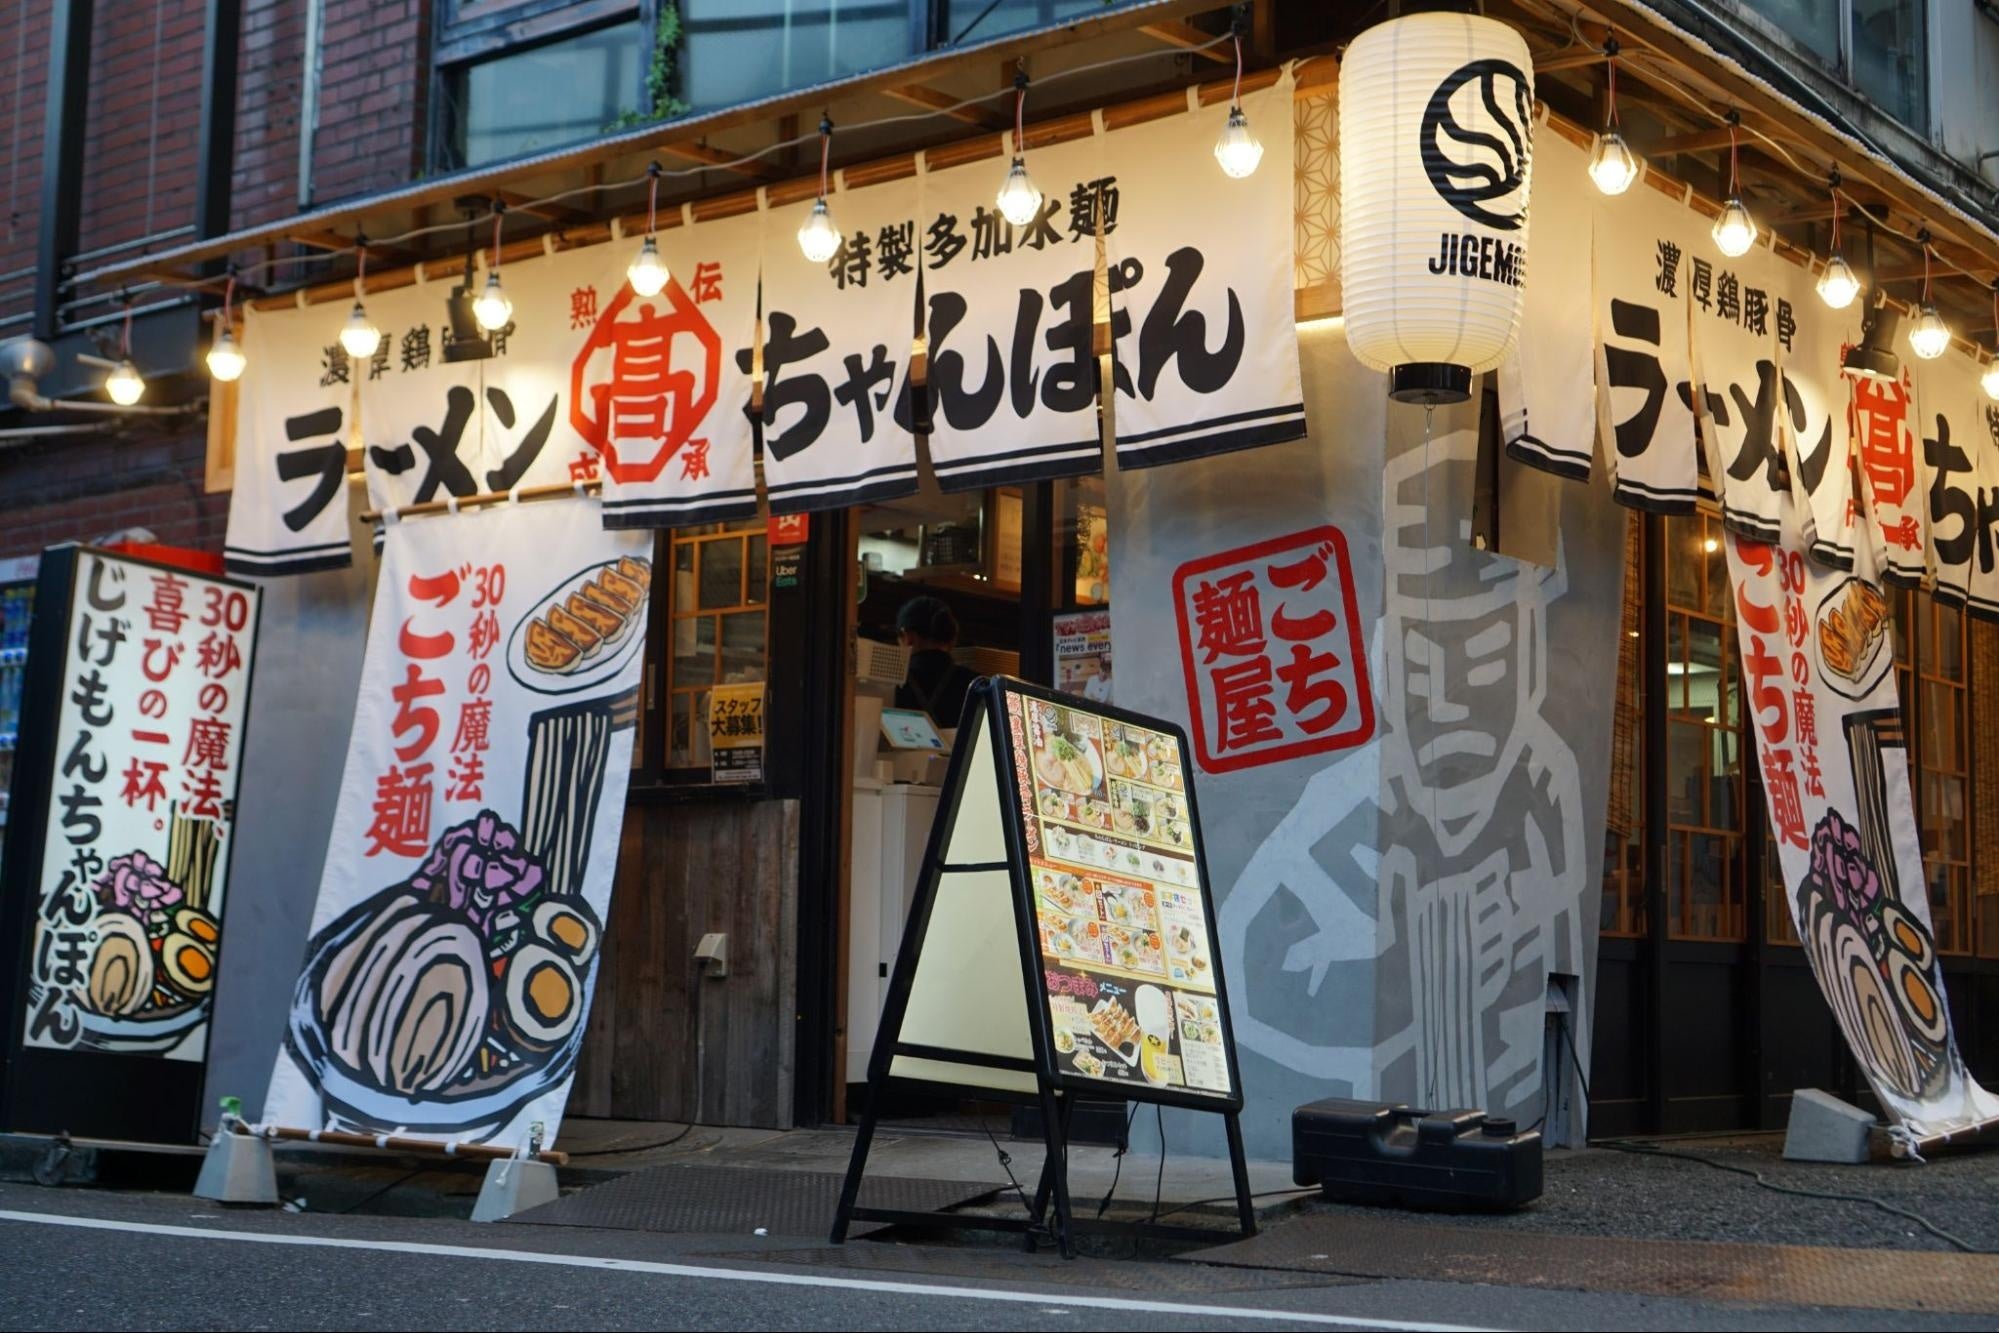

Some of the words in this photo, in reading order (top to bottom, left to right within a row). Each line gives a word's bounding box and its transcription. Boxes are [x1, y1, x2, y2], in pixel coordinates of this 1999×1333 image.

[690, 262, 722, 304] 伝
[829, 176, 1119, 289] 特製多加水麺
[1656, 239, 1796, 353] 濃厚鶏豚骨
[735, 247, 1244, 462] ちゃんぽん
[1603, 298, 1831, 497] ラーメン
[277, 386, 558, 532] ラーメン
[776, 566, 797, 576] Uber
[1192, 570, 1283, 753] 麺屋
[1267, 542, 1348, 735] ごち
[120, 572, 189, 832] 喜びの一杯。
[364, 562, 471, 858] ごち麺
[445, 563, 505, 802] 30秒の魔法
[713, 698, 761, 714] スタッフ
[1777, 545, 1825, 800] 30秒の魔法
[30, 558, 130, 1045] じげもんちゃんぽん
[1045, 969, 1099, 998] おつまみ
[1100, 982, 1127, 995] メニュー
